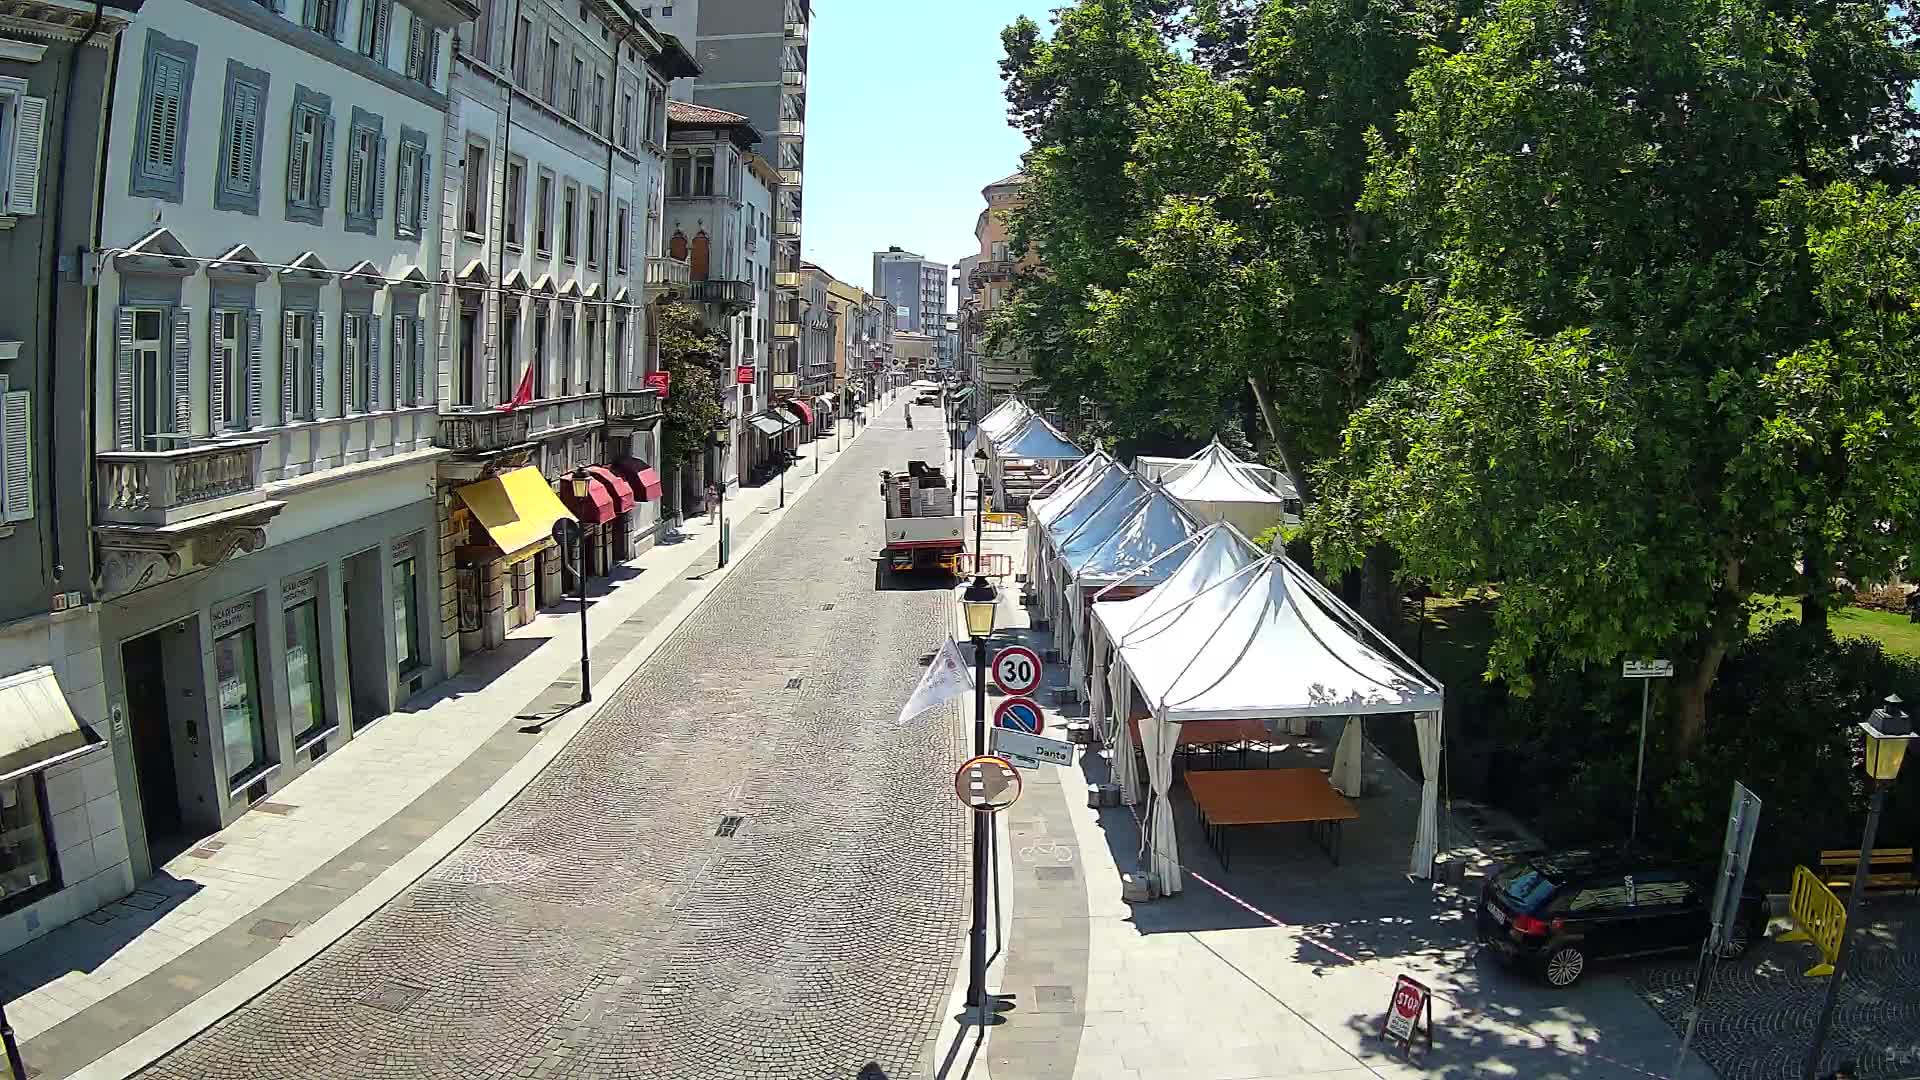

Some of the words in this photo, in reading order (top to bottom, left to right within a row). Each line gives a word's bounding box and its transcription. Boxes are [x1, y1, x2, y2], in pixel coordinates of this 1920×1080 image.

[1003, 661, 1031, 682] 30
[1036, 746, 1066, 760] Dante
[1397, 992, 1420, 1012] STOP
